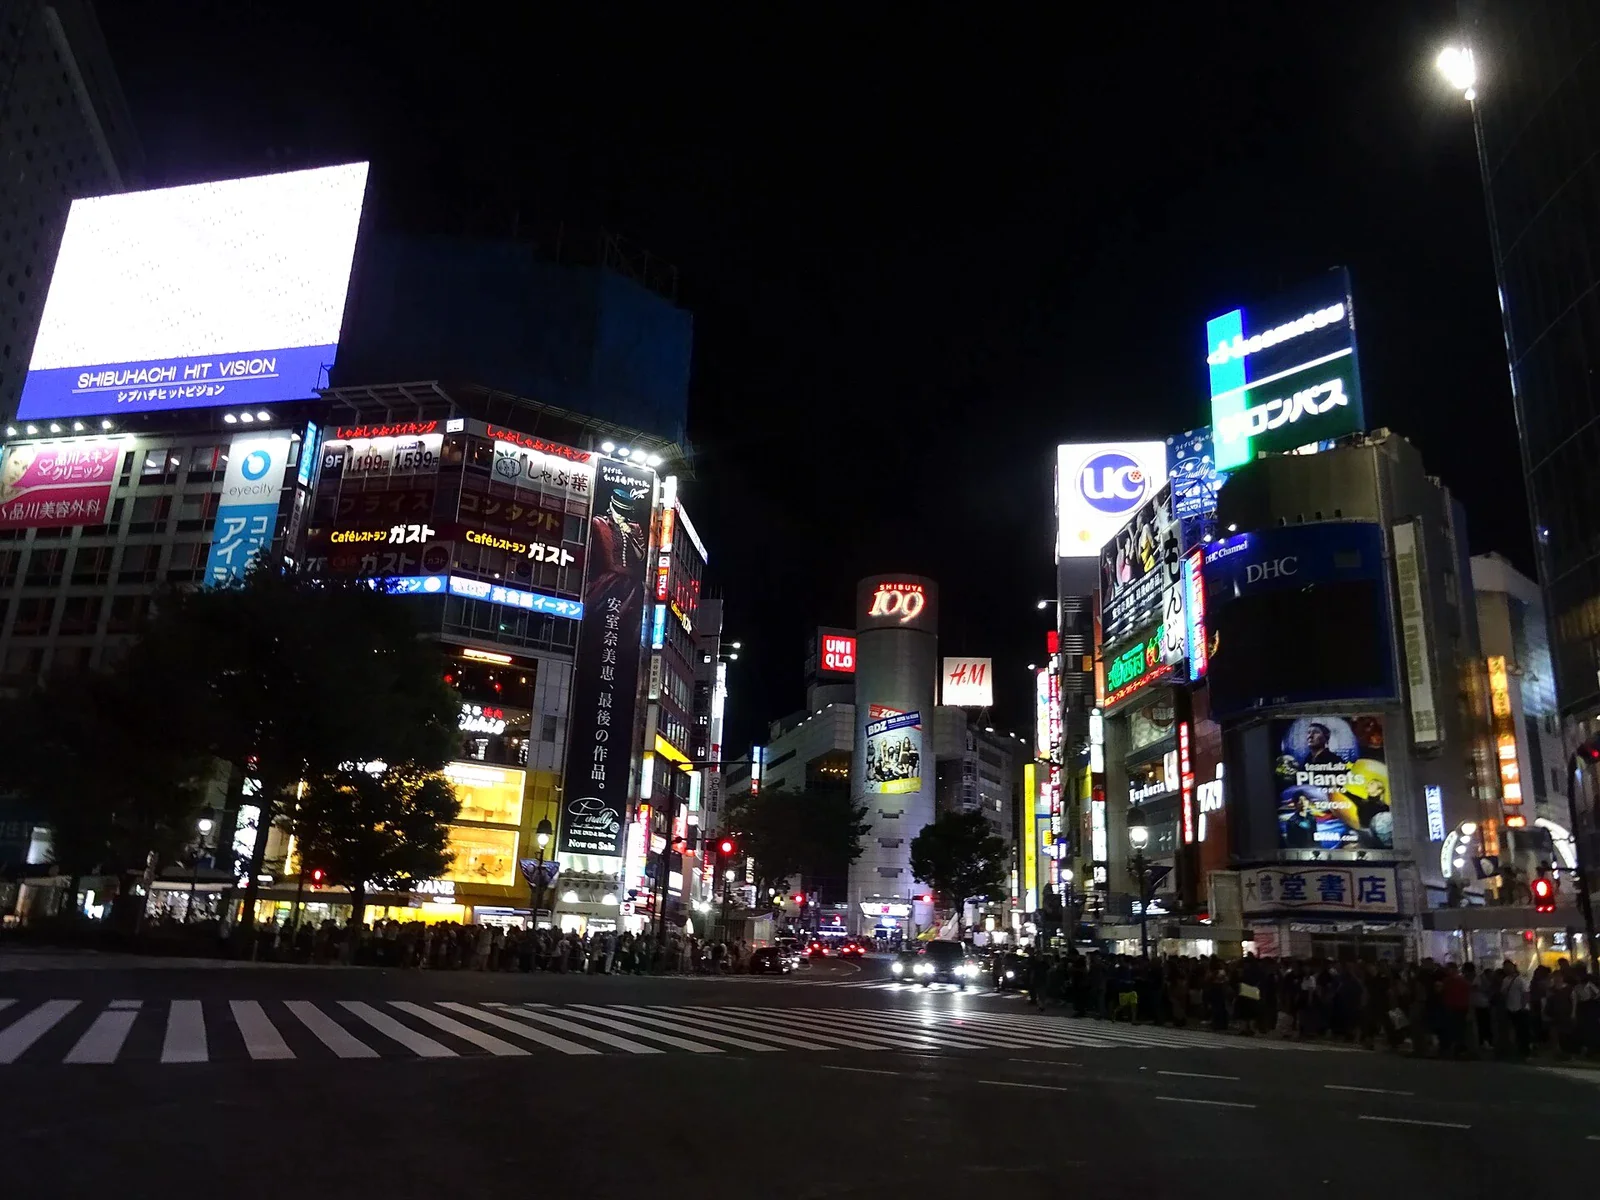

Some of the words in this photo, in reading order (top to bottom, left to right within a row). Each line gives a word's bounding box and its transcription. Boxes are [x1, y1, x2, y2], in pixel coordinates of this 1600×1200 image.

[77, 369, 177, 389] SHIBUHACHI
[184, 362, 213, 381] HIT
[218, 357, 277, 377] VISION
[117, 385, 226, 403] シブハチヒットビジョン
[336, 420, 438, 439] しゃぶしゃぶバイキング
[485, 423, 592, 462] しゃぶしゃぶバイキング
[54, 449, 114, 467] 品川スキン
[324, 454, 343, 468] 9F
[393, 450, 440, 472] 1,599円
[52, 464, 105, 481] クリニック
[526, 459, 589, 493] しゃぶ葉
[229, 483, 275, 498] eyecity
[9, 498, 101, 521] 品川美容外科
[388, 524, 436, 545] ガスト
[527, 541, 575, 568] ガスト
[1218, 540, 1248, 560] Channel
[358, 552, 416, 575] ガスト
[1246, 556, 1298, 584] DHC
[879, 583, 923, 593] SHIBUYA
[867, 590, 925, 623] 109
[826, 639, 852, 654] UNI
[825, 653, 853, 668] QLO
[949, 662, 986, 687] H&M
[591, 597, 622, 790] 安室奈美恵、最後の作品。
[867, 720, 888, 736] BDZ
[1304, 762, 1346, 771] teamLab
[1296, 771, 1366, 787] Planets
[567, 838, 588, 848] Now
[587, 841, 598, 850] on
[598, 841, 616, 851] Sale
